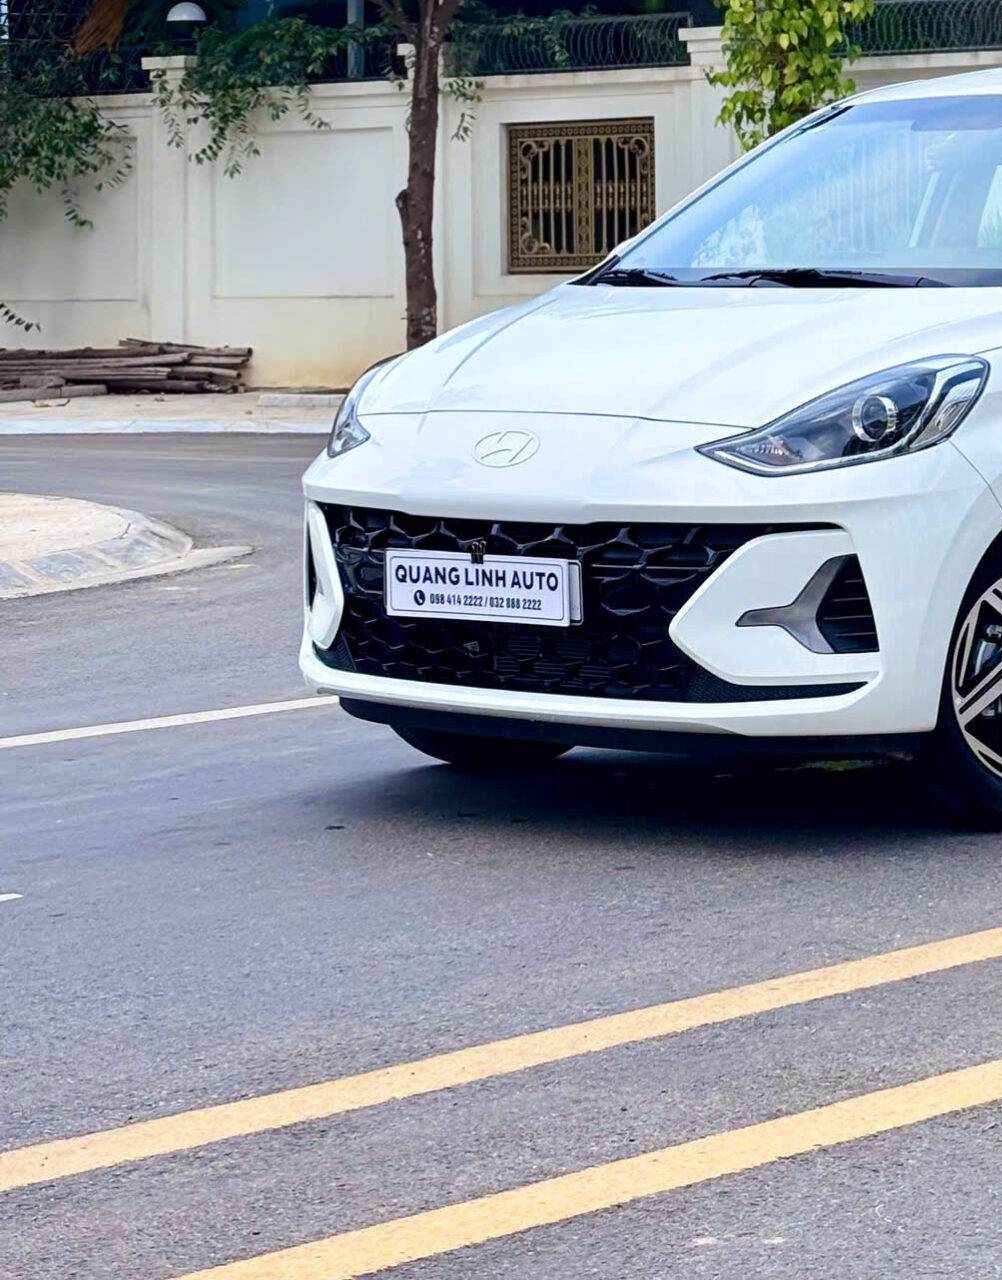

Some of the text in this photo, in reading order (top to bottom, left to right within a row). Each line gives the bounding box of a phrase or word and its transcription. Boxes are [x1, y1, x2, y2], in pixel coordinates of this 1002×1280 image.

[395, 564, 559, 592] QUANG LINH AUTO
[430, 593, 445, 605] 098
[446, 594, 462, 606] 414
[463, 595, 482, 607] 2222
[489, 597, 504, 609] 032
[522, 598, 542, 611] 2222
